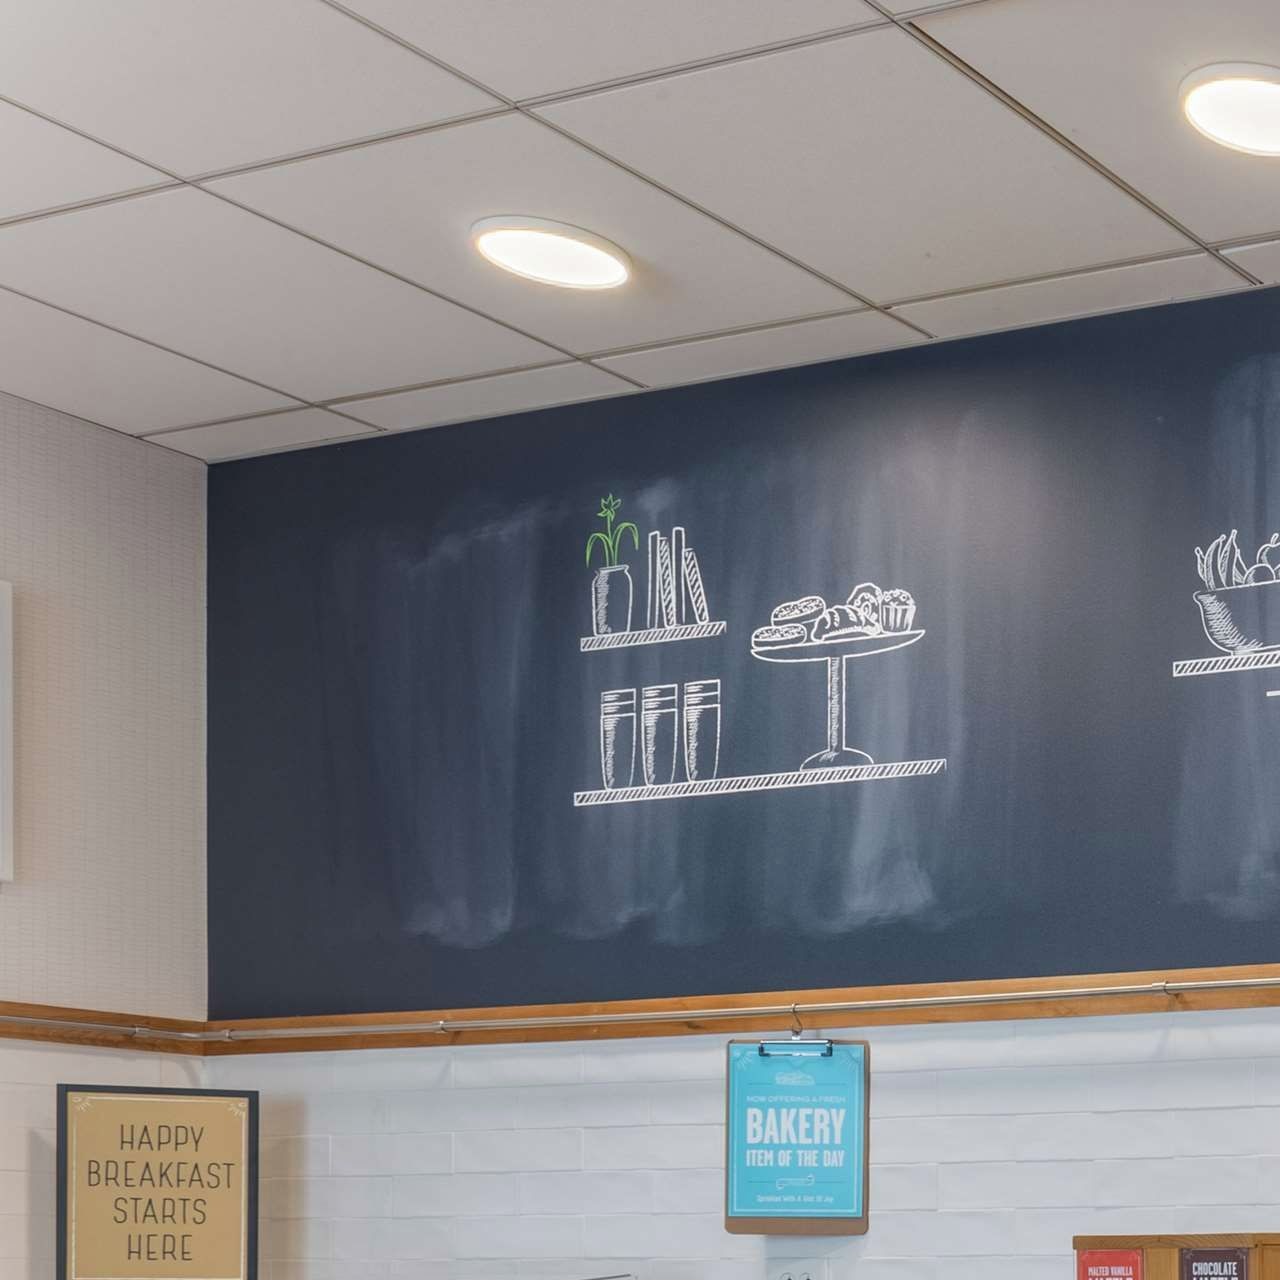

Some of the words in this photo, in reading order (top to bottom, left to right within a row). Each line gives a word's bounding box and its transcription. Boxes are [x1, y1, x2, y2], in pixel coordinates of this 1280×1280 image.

[120, 1124, 204, 1152] HAPPY
[746, 1107, 847, 1145] BAKERY
[746, 1149, 774, 1167] ITEM
[777, 1149, 793, 1167] OF
[797, 1149, 819, 1167] THE
[823, 1149, 845, 1168] DAY
[87, 1159, 235, 1189] BREAKFAST
[113, 1197, 207, 1225] STARTS
[127, 1233, 193, 1261] HERE
[1088, 1266, 1109, 1277] MALTED
[1110, 1266, 1133, 1277] VANILLA
[1192, 1262, 1238, 1276] CHOCOLATE
